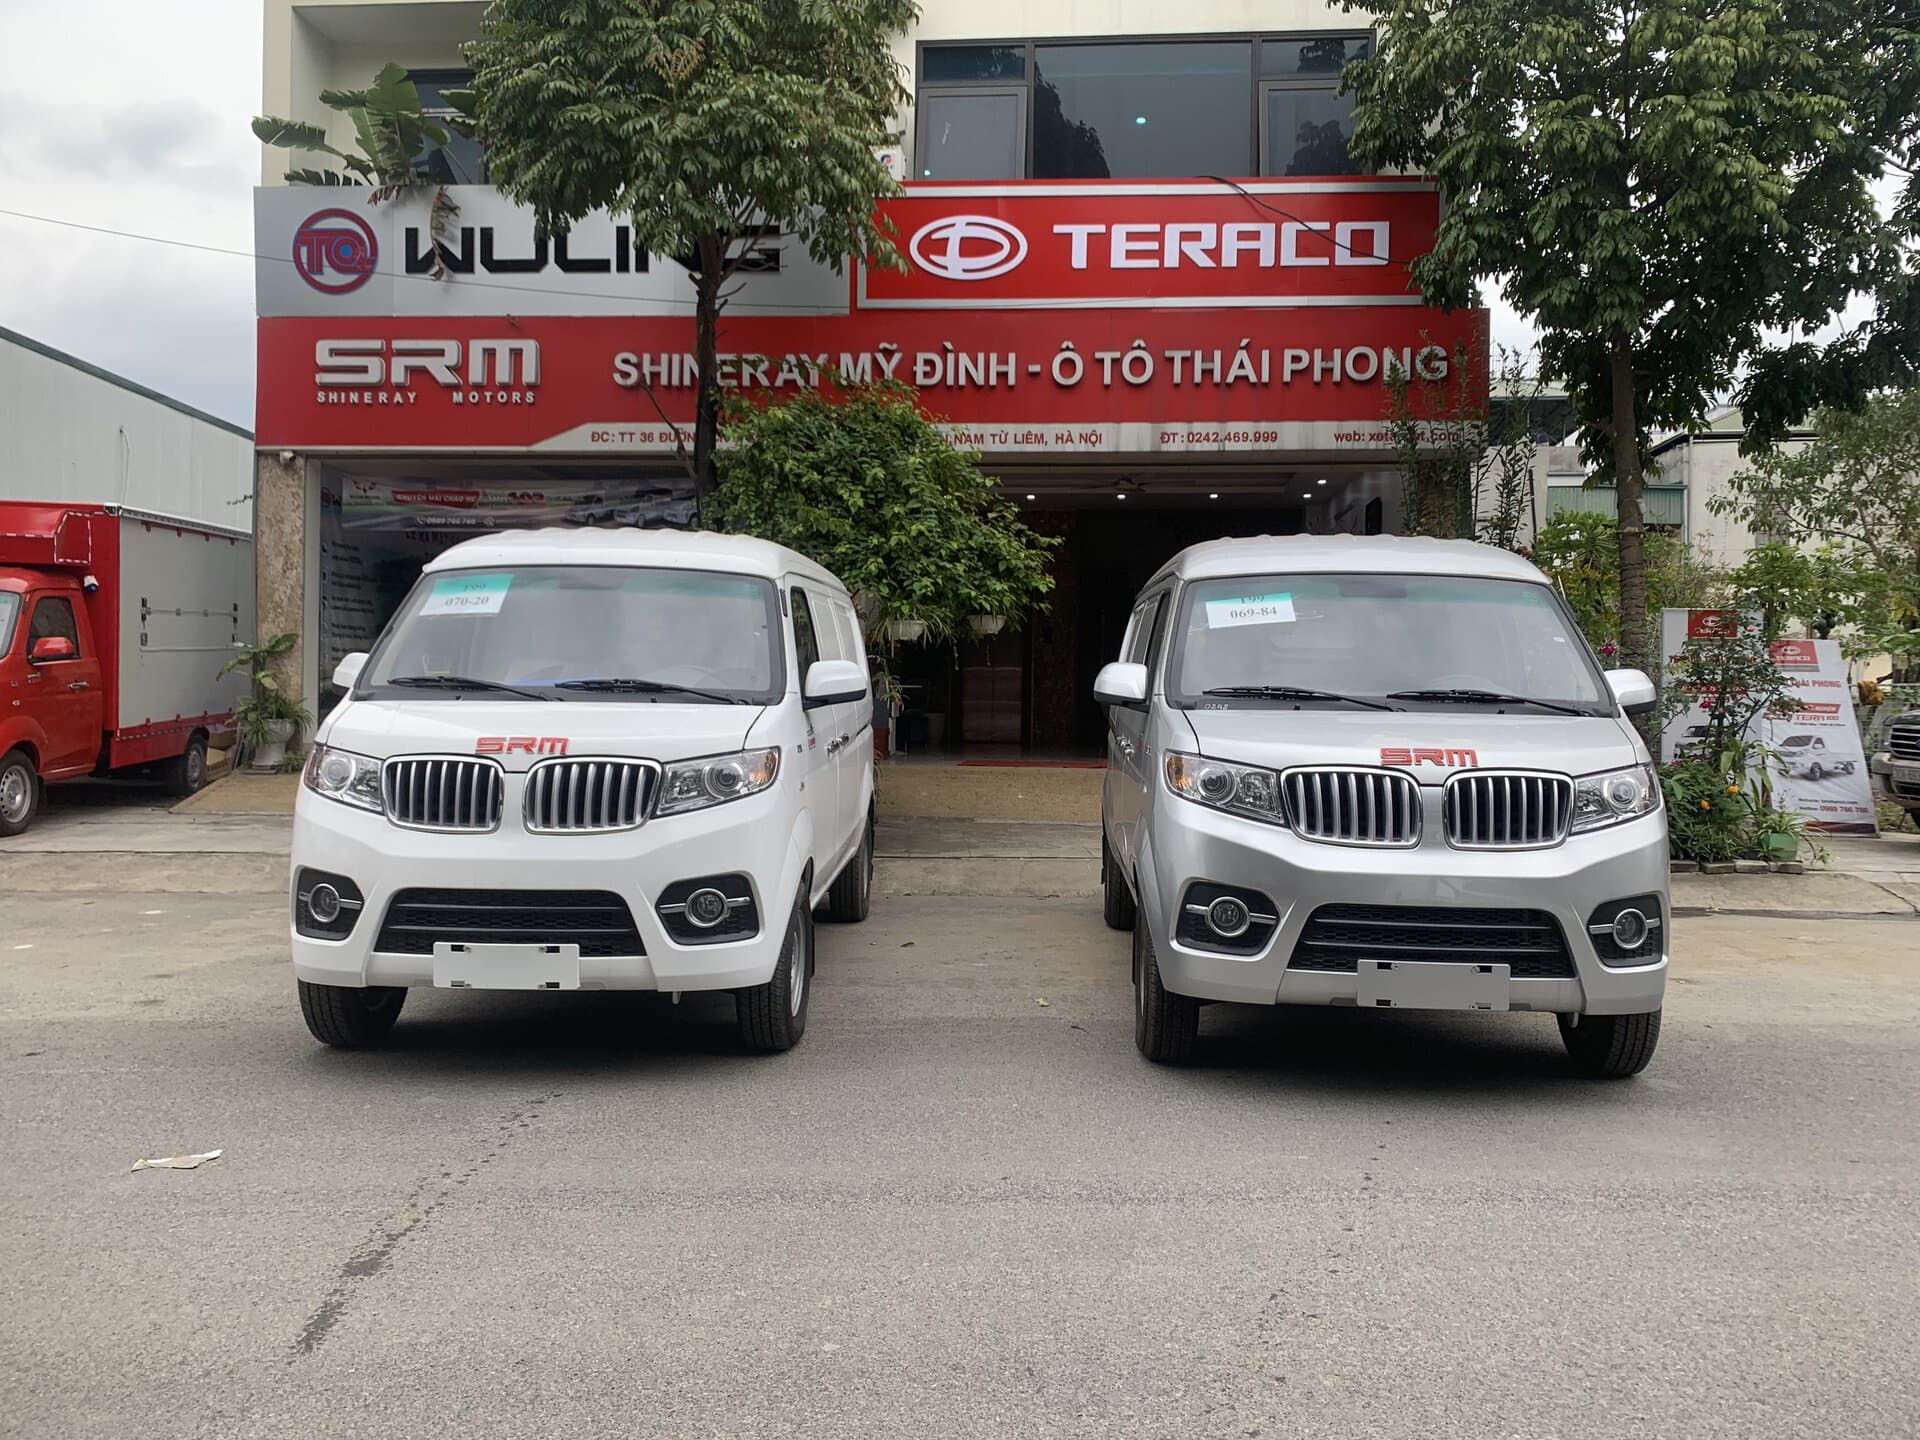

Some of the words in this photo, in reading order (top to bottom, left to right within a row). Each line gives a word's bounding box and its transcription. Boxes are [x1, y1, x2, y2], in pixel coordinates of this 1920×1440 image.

[405, 225, 781, 274] WULIG
[1053, 221, 1391, 269] TERACO
[315, 339, 541, 387] SRM
[612, 352, 829, 388] SHINERAY
[839, 342, 904, 387] MỸ
[914, 341, 1017, 387] ĐÌNH
[1051, 340, 1085, 386] Ô
[1095, 339, 1155, 386] TÔ
[1165, 338, 1270, 385] THÁI
[1282, 345, 1449, 382] PHONG
[316, 391, 418, 405] SHINERAY
[452, 391, 537, 405] MOTORS
[619, 432, 636, 443] TT
[640, 432, 654, 443] 36
[953, 432, 984, 445] NAM
[990, 430, 1009, 445] TỪ
[1014, 430, 1048, 446] LIÊM,
[1055, 430, 1075, 445] HÀ
[1079, 430, 1102, 447] NỘI
[1334, 430, 1365, 442] web:
[1230, 606, 1277, 619] 069-84
[475, 737, 569, 755] SRM
[1380, 748, 1478, 767] SRM
